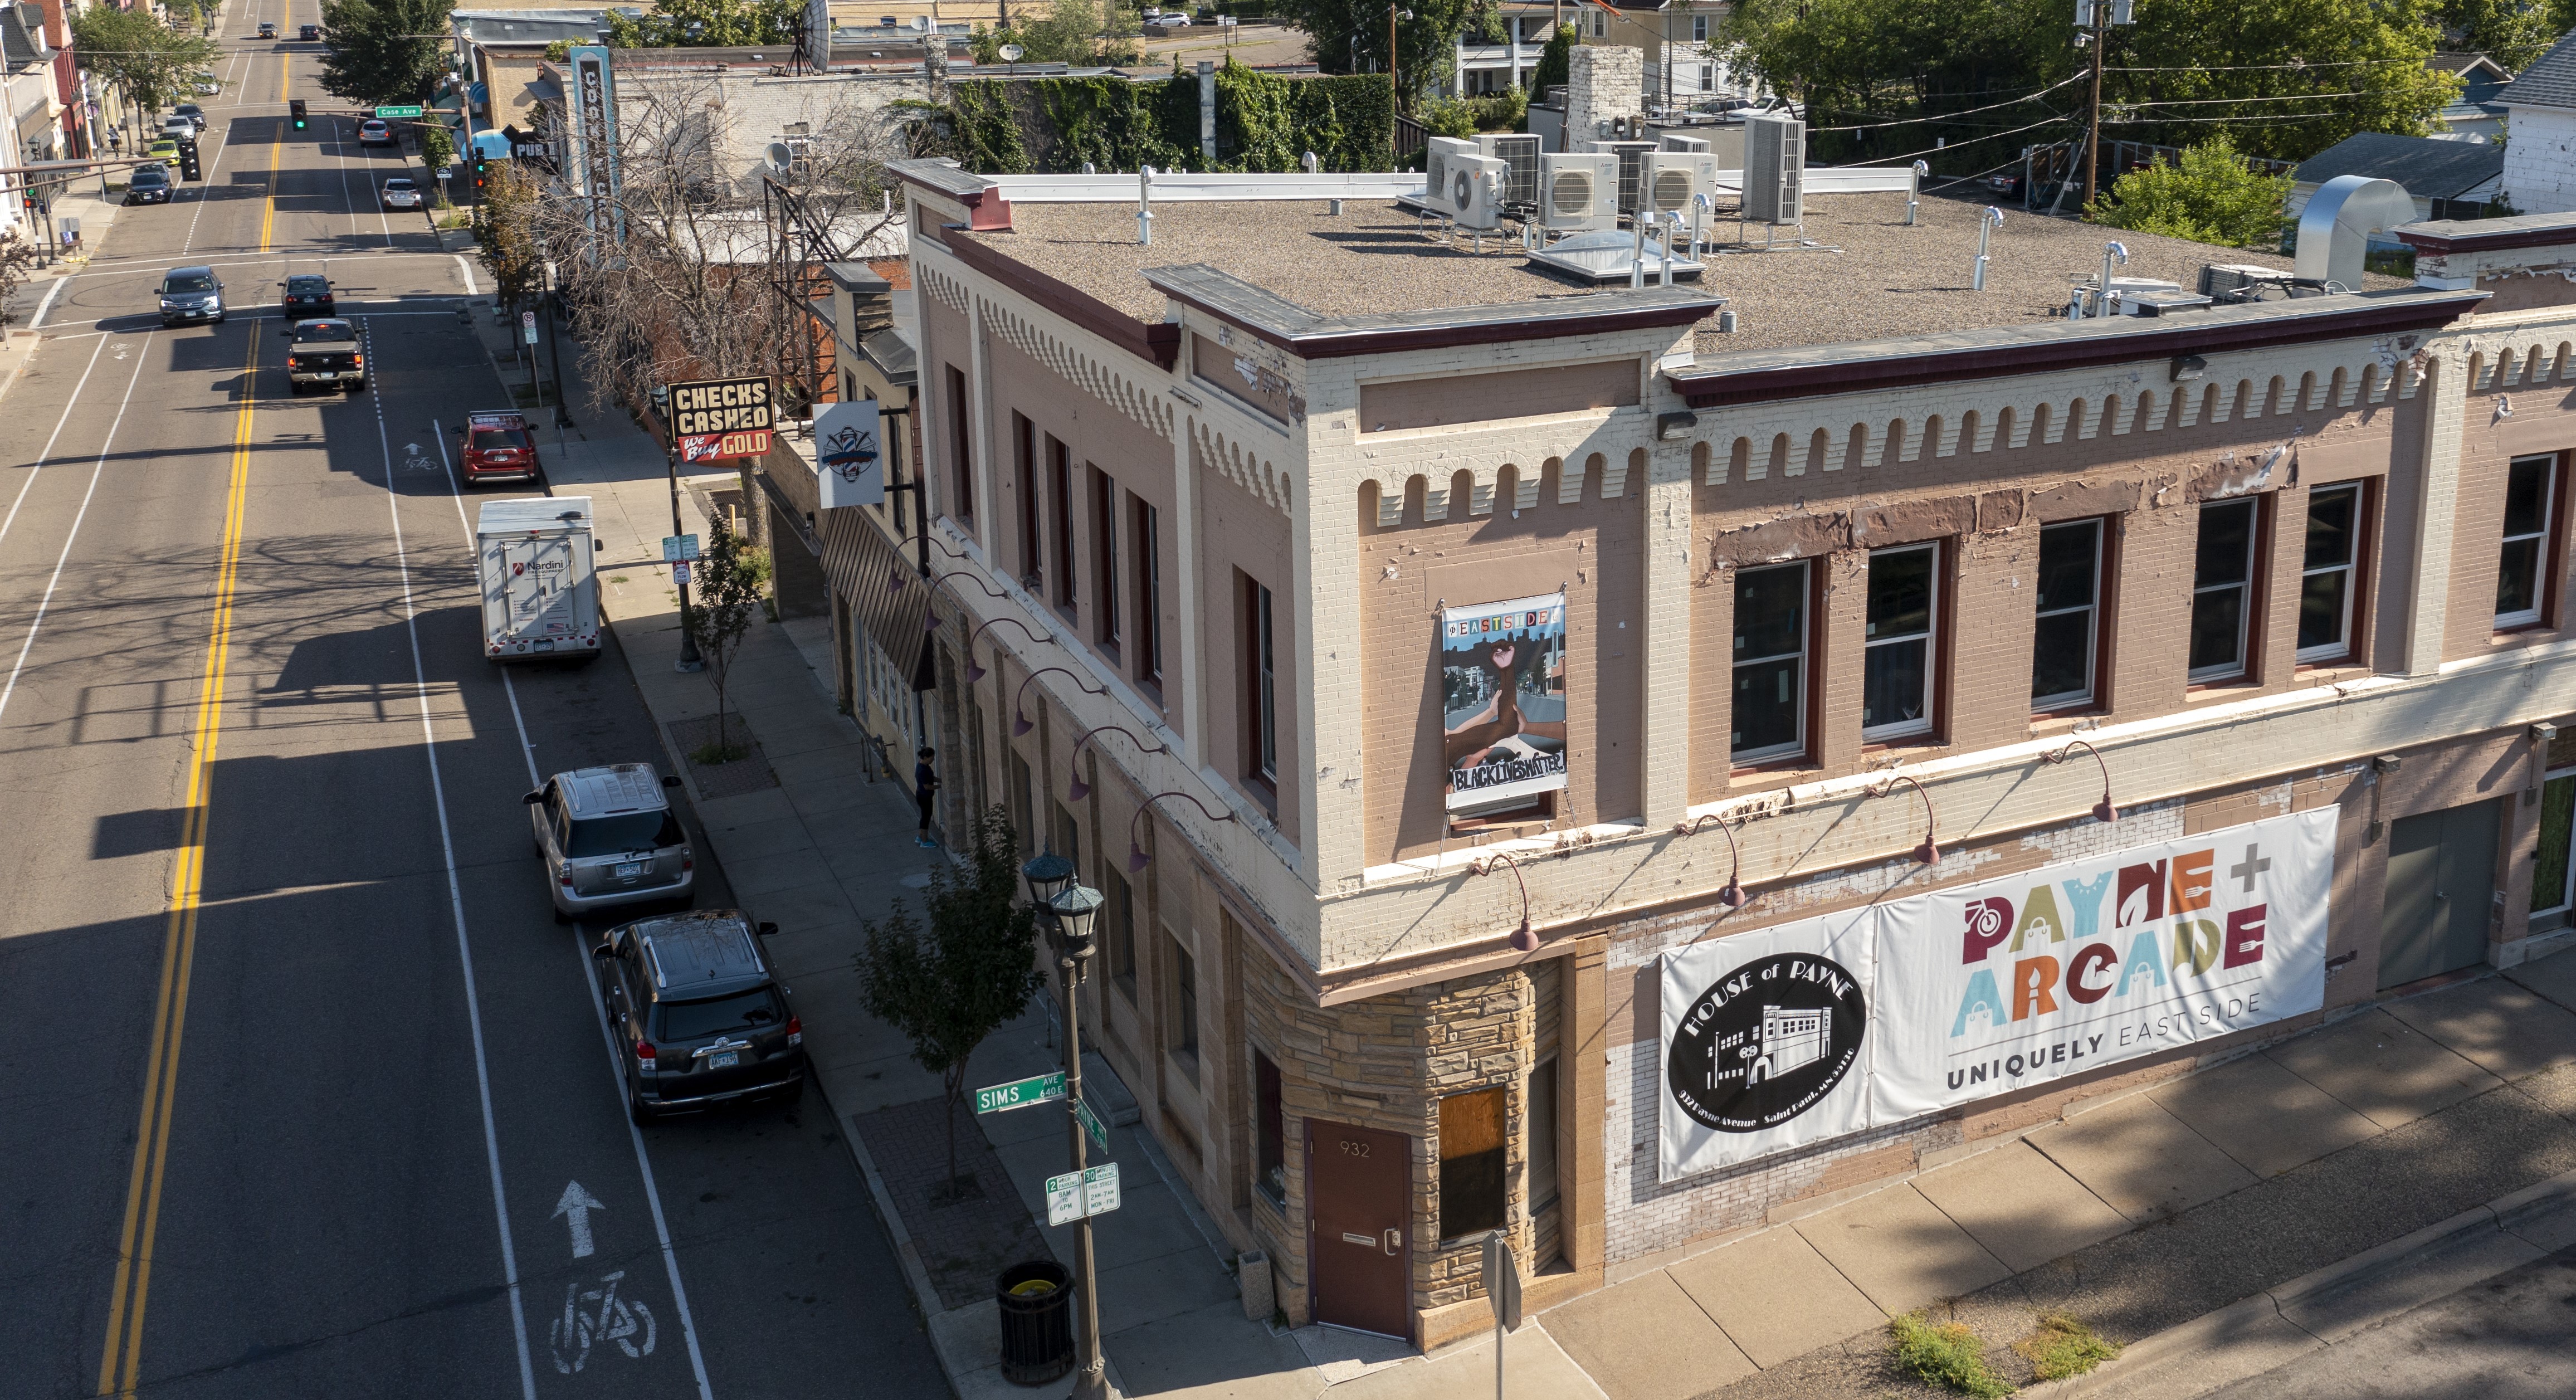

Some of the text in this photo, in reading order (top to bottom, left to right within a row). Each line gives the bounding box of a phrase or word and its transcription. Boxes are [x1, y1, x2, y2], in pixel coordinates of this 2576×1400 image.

[516, 144, 544, 156] PUB
[676, 383, 767, 410] CHECKS
[679, 406, 768, 433] CASHED
[684, 437, 705, 450] We
[687, 432, 768, 461] Buy GOLD
[527, 560, 563, 570] Nardini
[1962, 848, 2215, 965] PAYNE
[1949, 903, 2268, 1038] ARCADE
[1684, 960, 1853, 1037] HOUSE of PAYNE
[1947, 992, 2261, 1091] UNIQUELY EAST SIDE
[1043, 1075, 1058, 1086] AVE
[1040, 1087, 1056, 1097] 640
[1679, 1090, 1695, 1108] 932
[1692, 1103, 1719, 1124] Payne
[1719, 1117, 1757, 1128] Avenue
[1764, 1109, 1791, 1124] Saint
[1818, 1076, 1834, 1093] MN
[1832, 1048, 1855, 1077] 55130
[980, 1086, 1019, 1109] SIMS
[1077, 1099, 1095, 1133] PAYNE
[1340, 1141, 1370, 1158] 932
[1097, 1165, 1114, 1174] MINUTE
[1097, 1171, 1115, 1179] PARKING
[1086, 1171, 1095, 1182] 30
[1050, 1181, 1057, 1191] 2
[1058, 1180, 1078, 1189] PARKING
[1099, 1179, 1115, 1188] STREET
[1058, 1190, 1071, 1198] 8AM
[1060, 1202, 1072, 1211] 6PM
